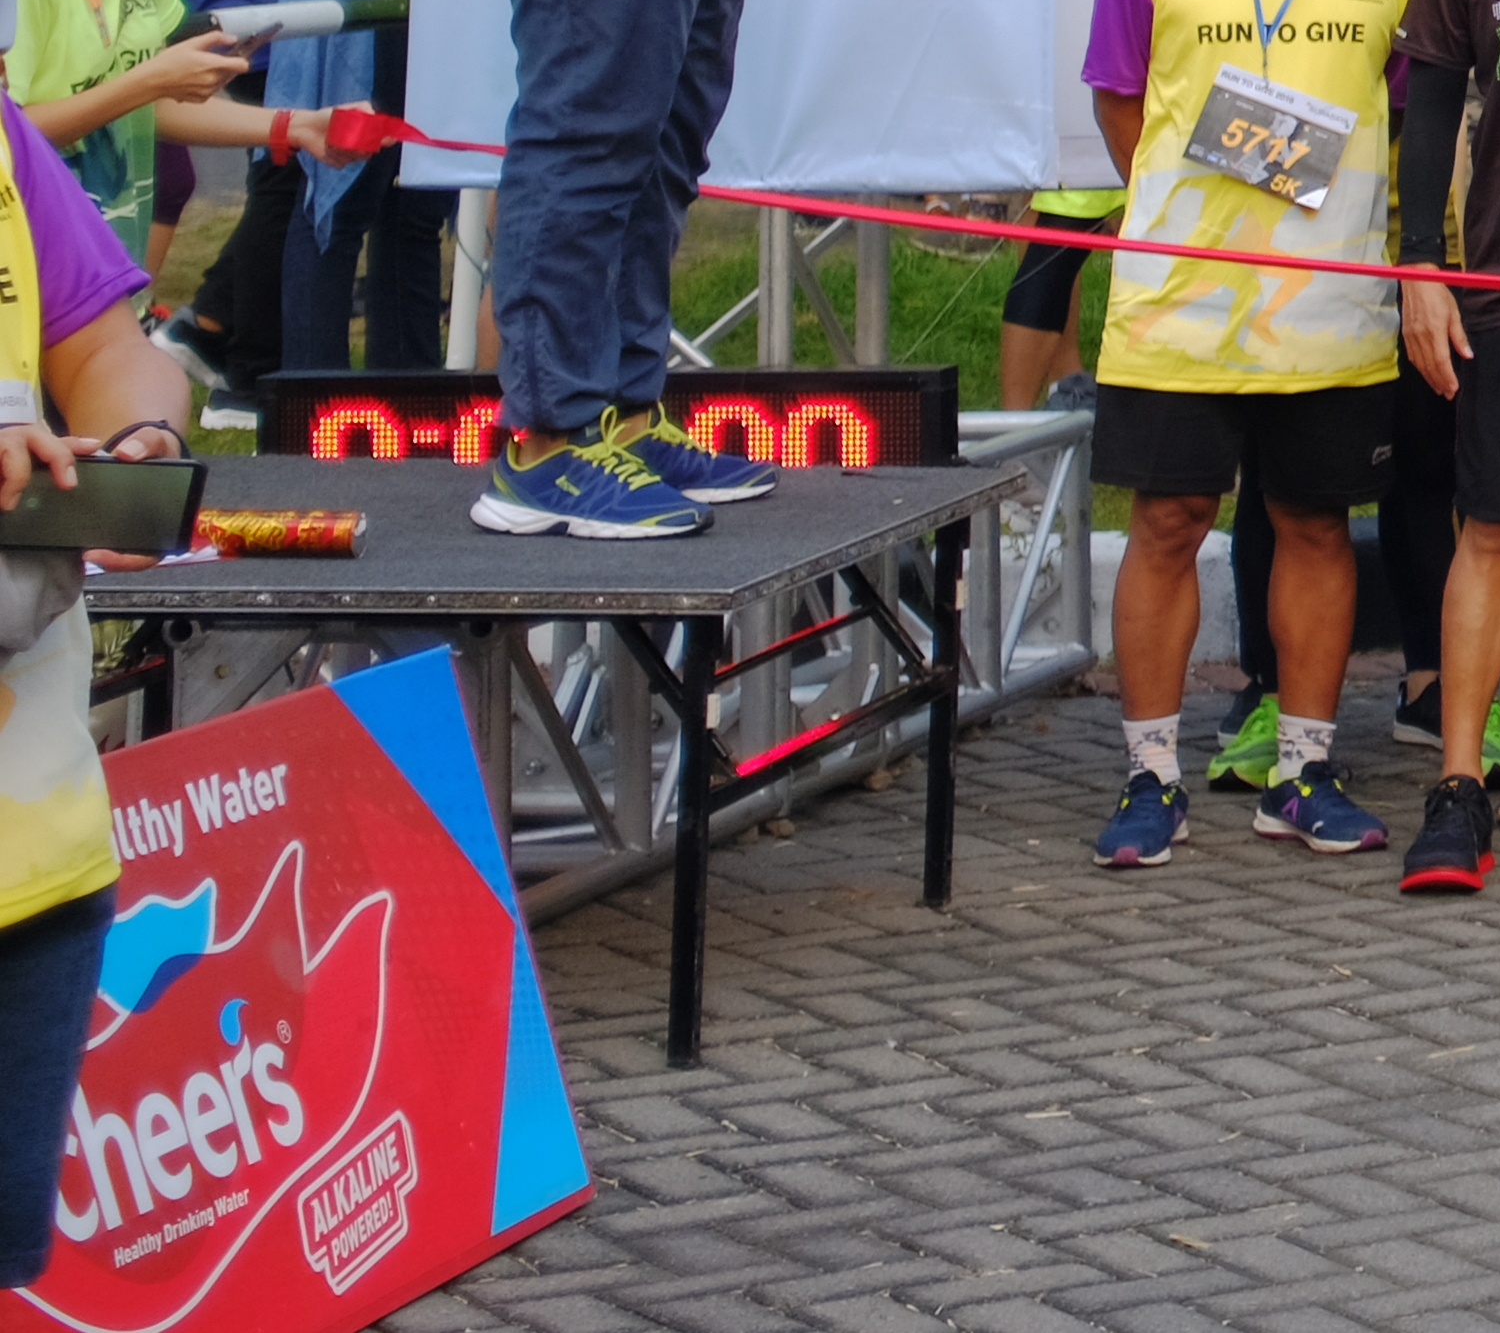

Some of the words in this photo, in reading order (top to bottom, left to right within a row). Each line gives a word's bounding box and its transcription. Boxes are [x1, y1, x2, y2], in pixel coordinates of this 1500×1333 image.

[1197, 23, 1253, 45] RUN
[1306, 22, 1365, 43] GIVE
[1221, 118, 1311, 170] 5717
[1270, 173, 1303, 198] 5K
[111, 798, 185, 864] lthy
[186, 761, 289, 833] Water
[310, 1131, 402, 1242] ALKALINE
[114, 1231, 163, 1270] Healthy
[164, 1206, 216, 1244] Drinking
[215, 1187, 250, 1224] Water
[331, 1192, 393, 1266] POWERED!
